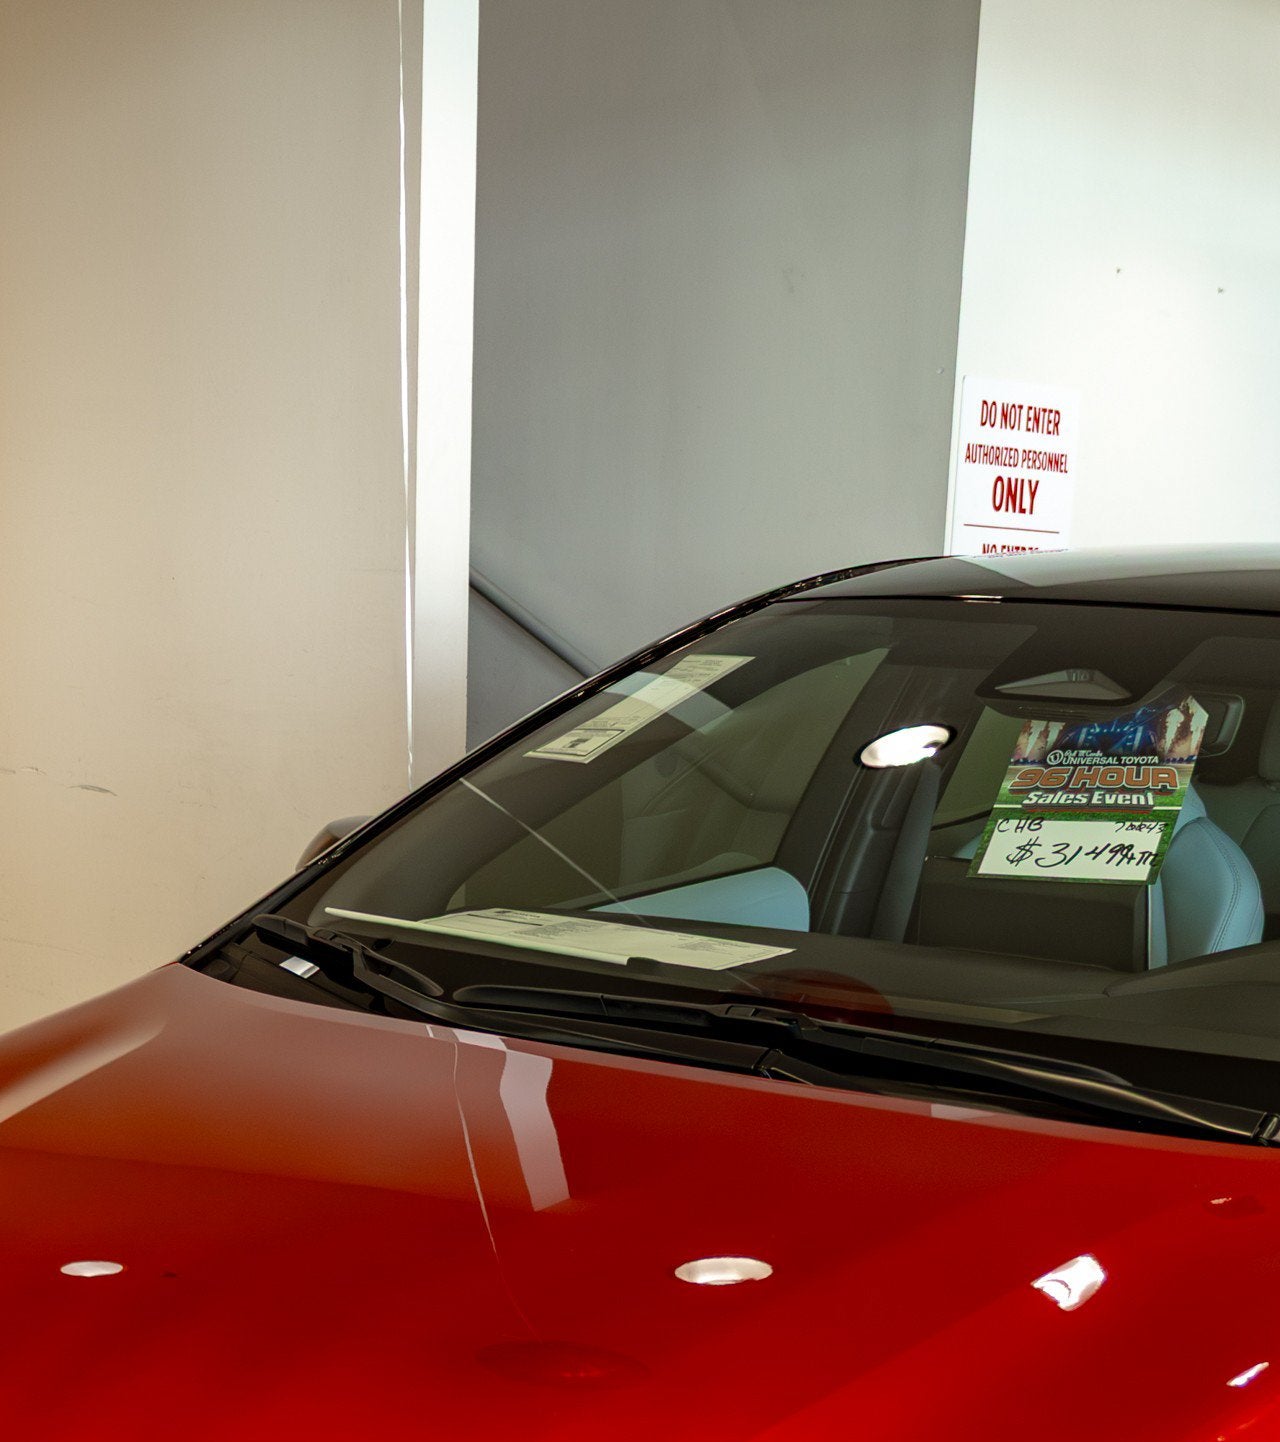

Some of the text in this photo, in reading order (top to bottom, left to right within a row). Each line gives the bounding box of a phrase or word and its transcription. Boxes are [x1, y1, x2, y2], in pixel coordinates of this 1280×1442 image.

[980, 400, 1061, 436] DO NOT ENTER
[964, 443, 1068, 474] AUTHORIZED PERSONNEL
[991, 475, 1039, 515] ONLY
[1063, 756, 1119, 765] UNIVERSAL
[1121, 755, 1159, 765] TOYOTA
[1008, 766, 1179, 790] 96 HOUR
[1022, 790, 1154, 806] Sales Event
